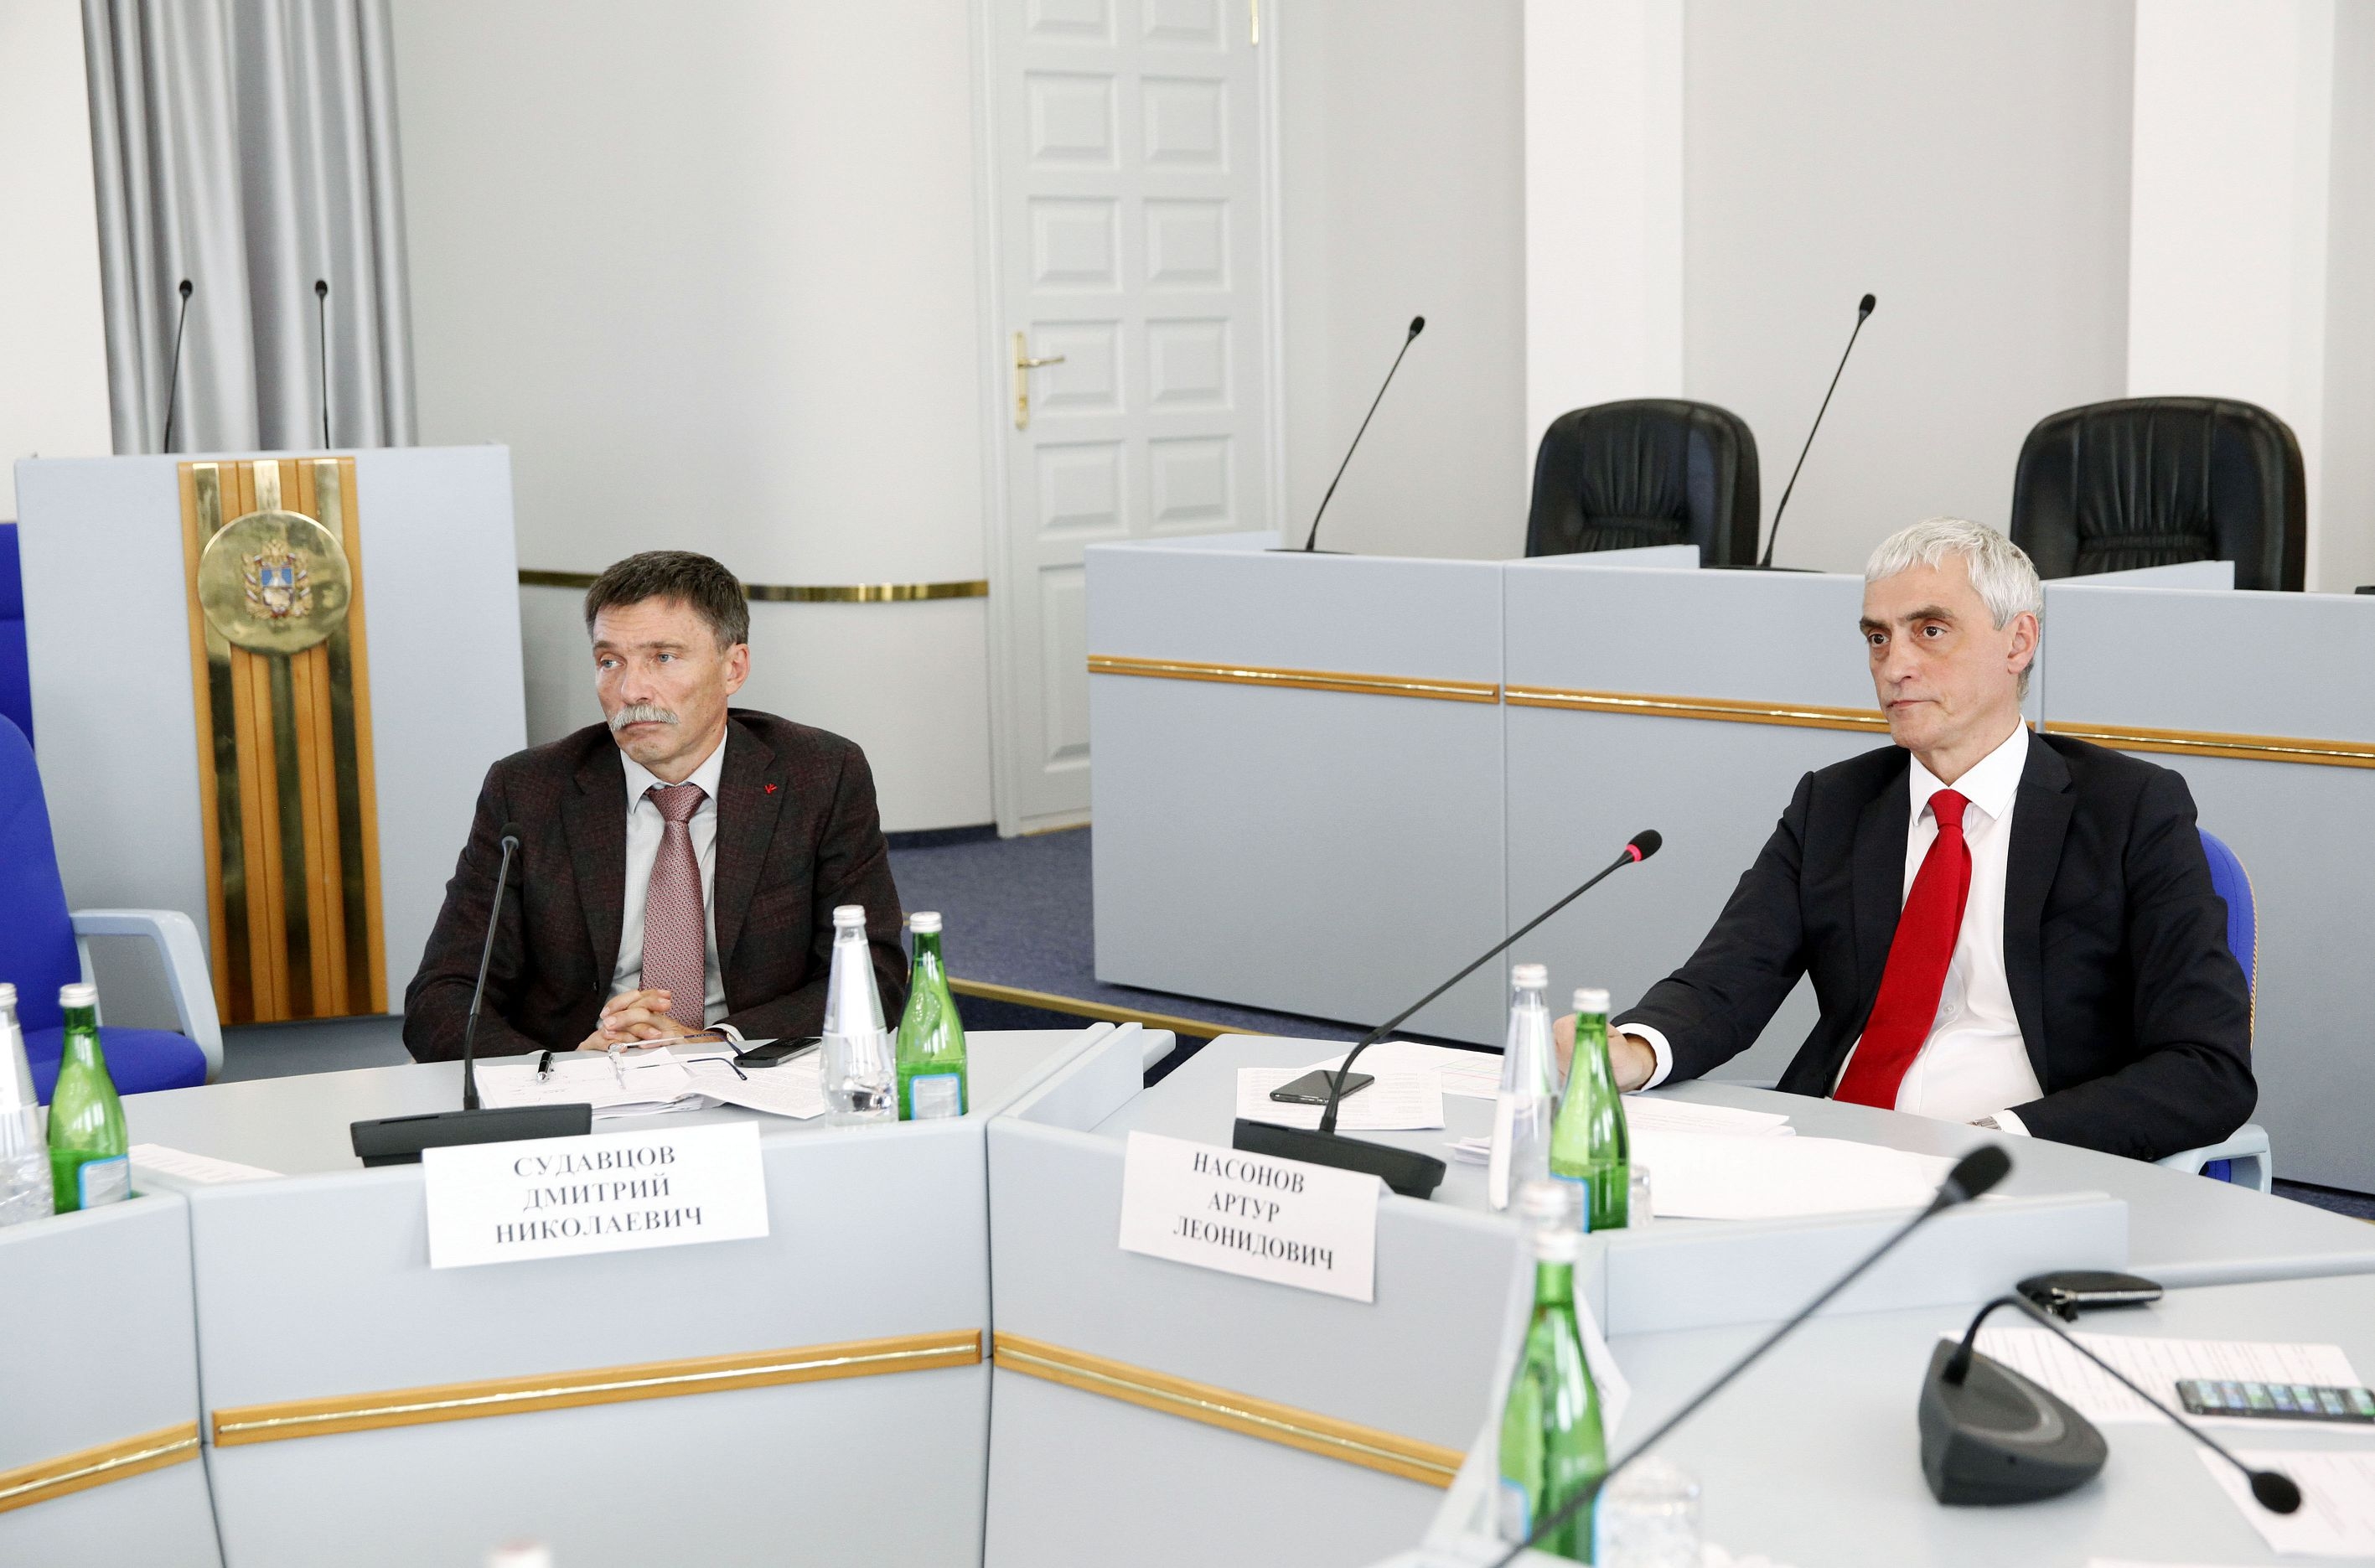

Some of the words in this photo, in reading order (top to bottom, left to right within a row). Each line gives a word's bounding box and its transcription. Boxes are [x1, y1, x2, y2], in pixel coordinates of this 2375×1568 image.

[514, 1146, 675, 1177] СУДАВЦОВ
[1193, 1152, 1304, 1193] НАСОНОВ
[524, 1173, 670, 1210] ДМИТРИЙ
[1208, 1192, 1280, 1223] АРТУР
[496, 1207, 702, 1244] НИКОЛАЕВИЧ
[1173, 1216, 1332, 1270] ЛЕОНИДОВИЧ
